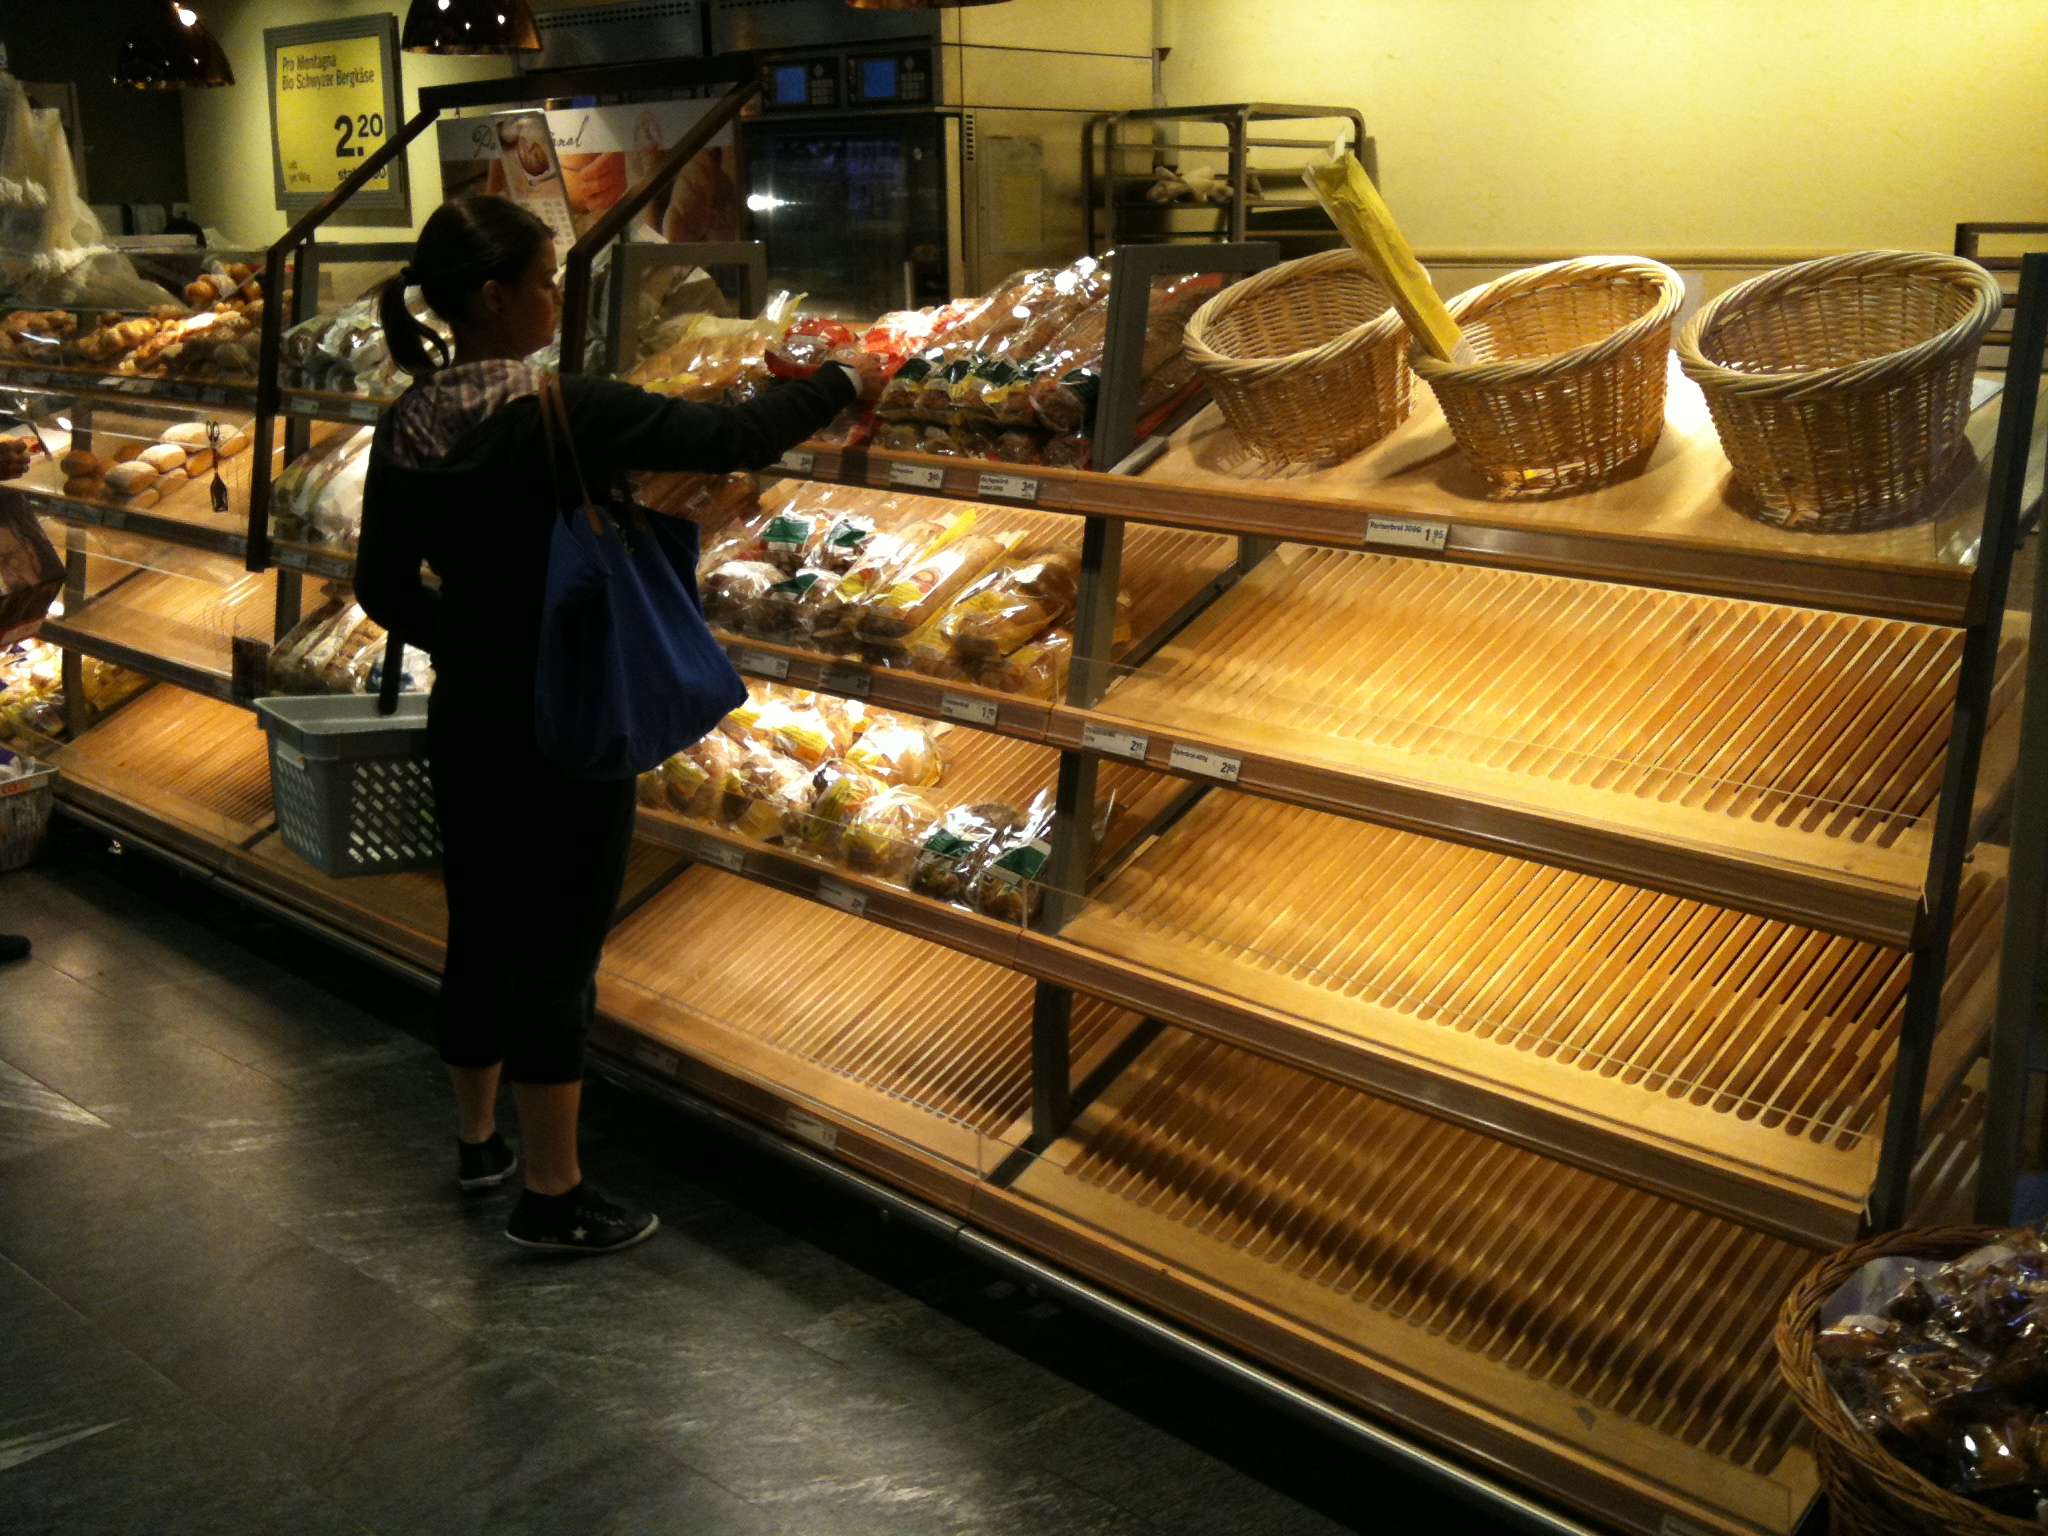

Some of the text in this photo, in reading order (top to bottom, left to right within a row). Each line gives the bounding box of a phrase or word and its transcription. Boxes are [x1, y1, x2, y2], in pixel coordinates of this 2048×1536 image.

[282, 53, 337, 72] Pro Montagna
[281, 74, 295, 91] Bio
[336, 67, 374, 88] Bergkäse
